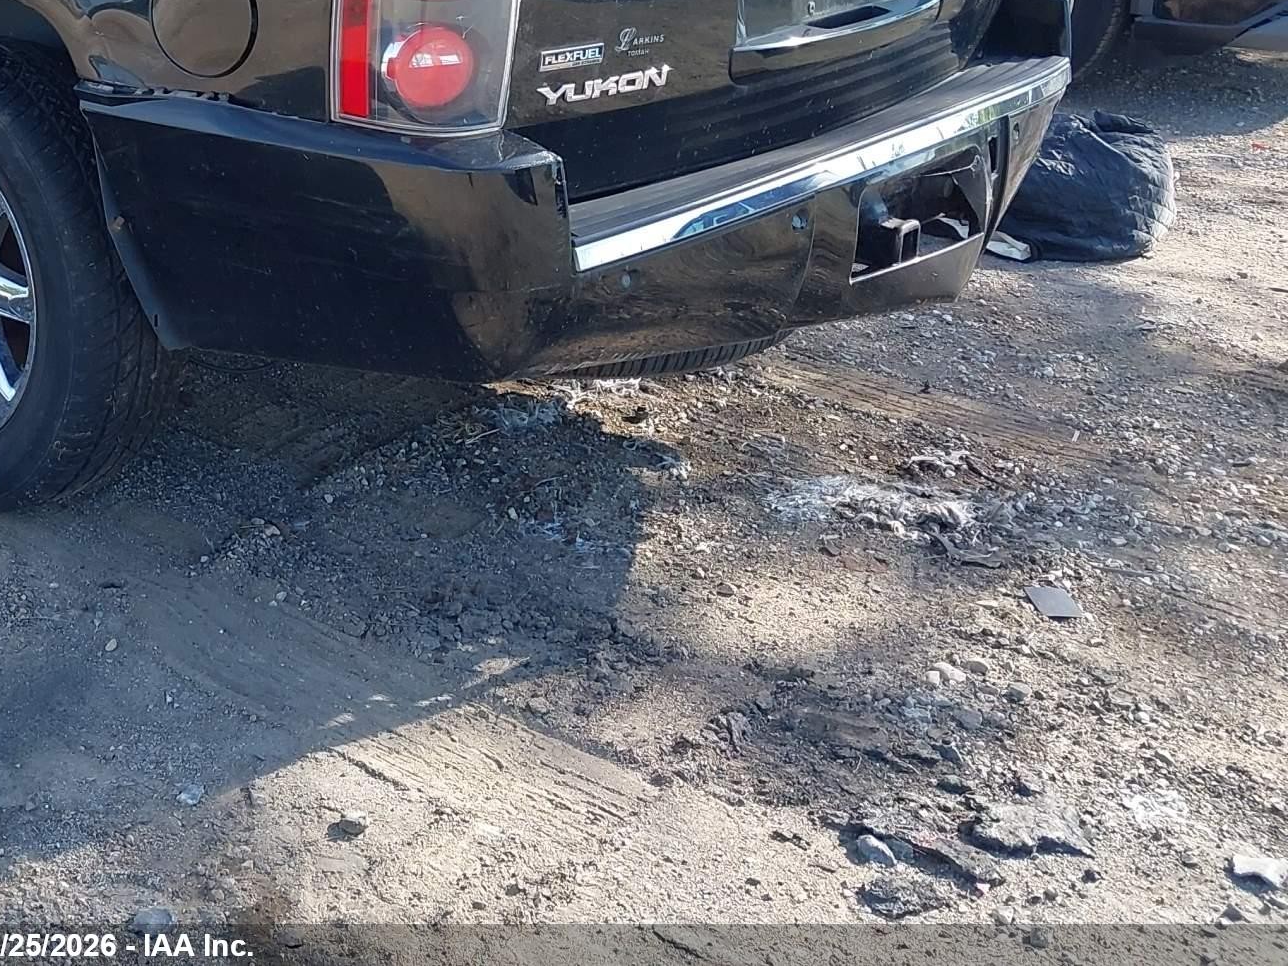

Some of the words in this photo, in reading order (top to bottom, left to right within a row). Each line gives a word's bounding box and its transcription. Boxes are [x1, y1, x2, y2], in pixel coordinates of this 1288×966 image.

[614, 26, 665, 52] LARKINS
[544, 47, 601, 66] FLEXFUEL
[536, 64, 674, 106] YUKON
